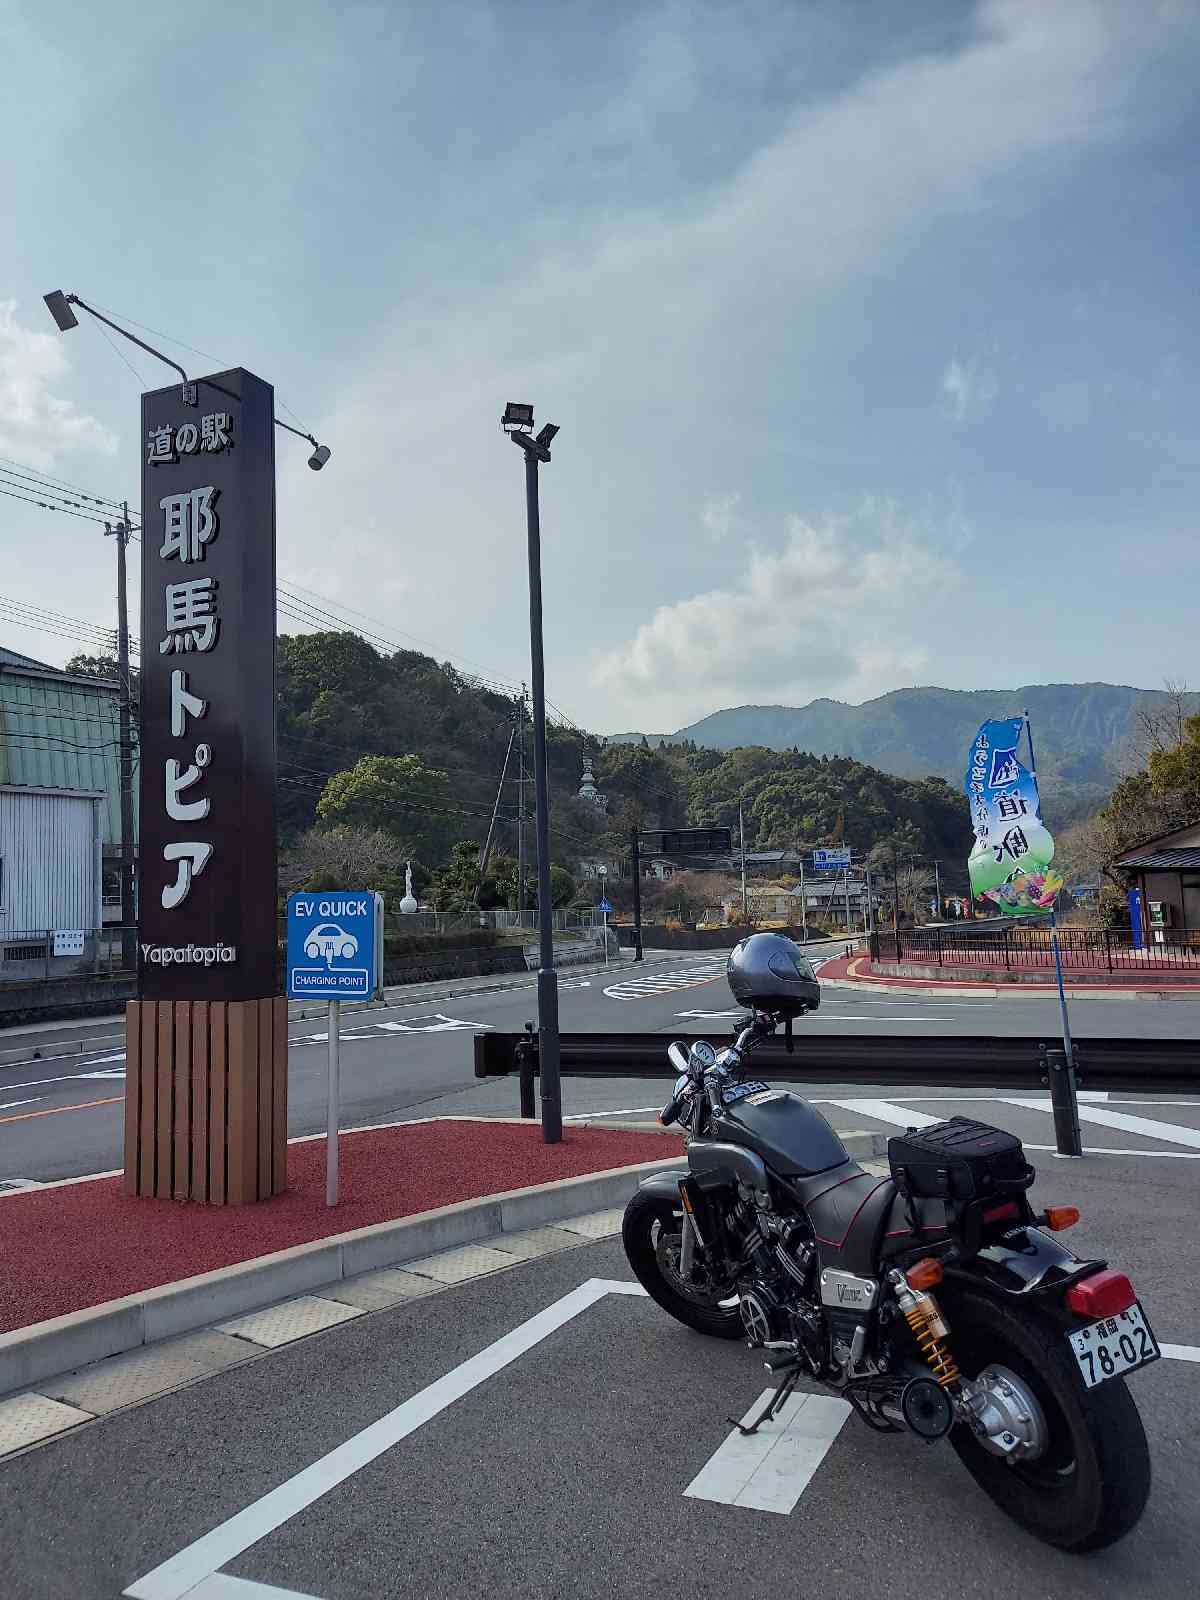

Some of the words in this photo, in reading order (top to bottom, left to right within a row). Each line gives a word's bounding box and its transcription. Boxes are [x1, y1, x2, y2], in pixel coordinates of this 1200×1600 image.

[147, 412, 230, 465] 道の駅
[160, 486, 217, 909] 耶馬トピア
[295, 901, 315, 917] EV
[319, 901, 367, 917] QUICK
[141, 942, 236, 966] Yapatopia
[295, 975, 337, 985] CHARGING
[338, 976, 365, 986] POINT
[1079, 1327, 1154, 1384] 78-02
